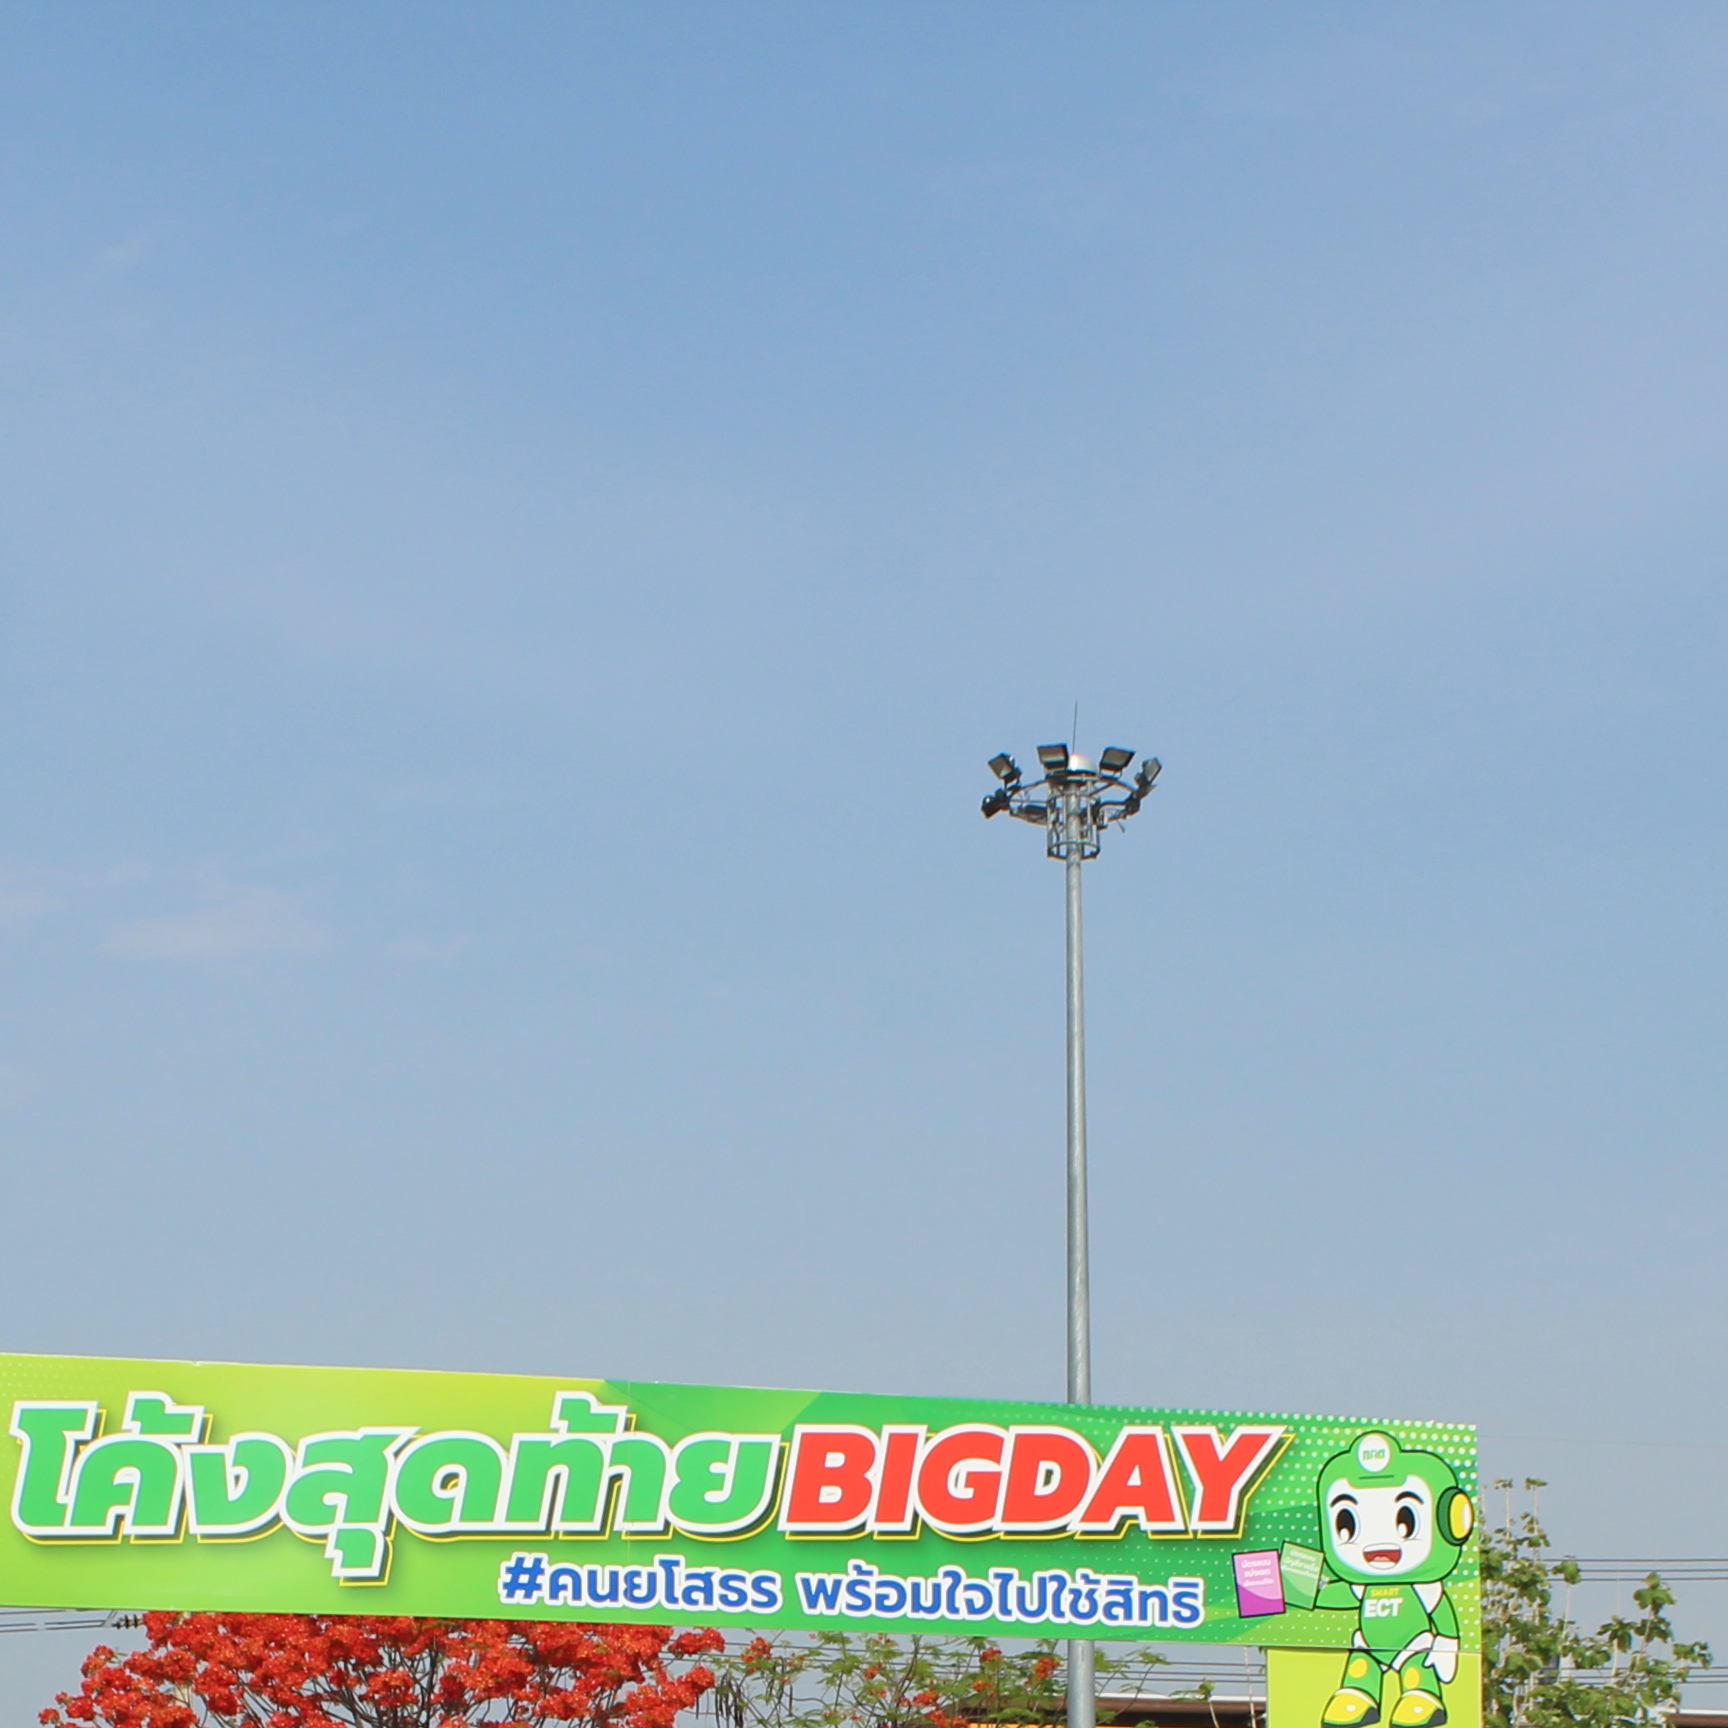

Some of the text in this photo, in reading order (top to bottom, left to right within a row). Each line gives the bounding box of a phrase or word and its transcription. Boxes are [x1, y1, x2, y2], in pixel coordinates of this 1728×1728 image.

[10, 1391, 1286, 1578] โค้งสุดท้าย BIGDAY
[503, 1555, 1203, 1626] #คนยโสธร พร้อมใจไปใช้สิทธิ
[1363, 1597, 1403, 1619] ECT
[1370, 1587, 1400, 1598] SMART
